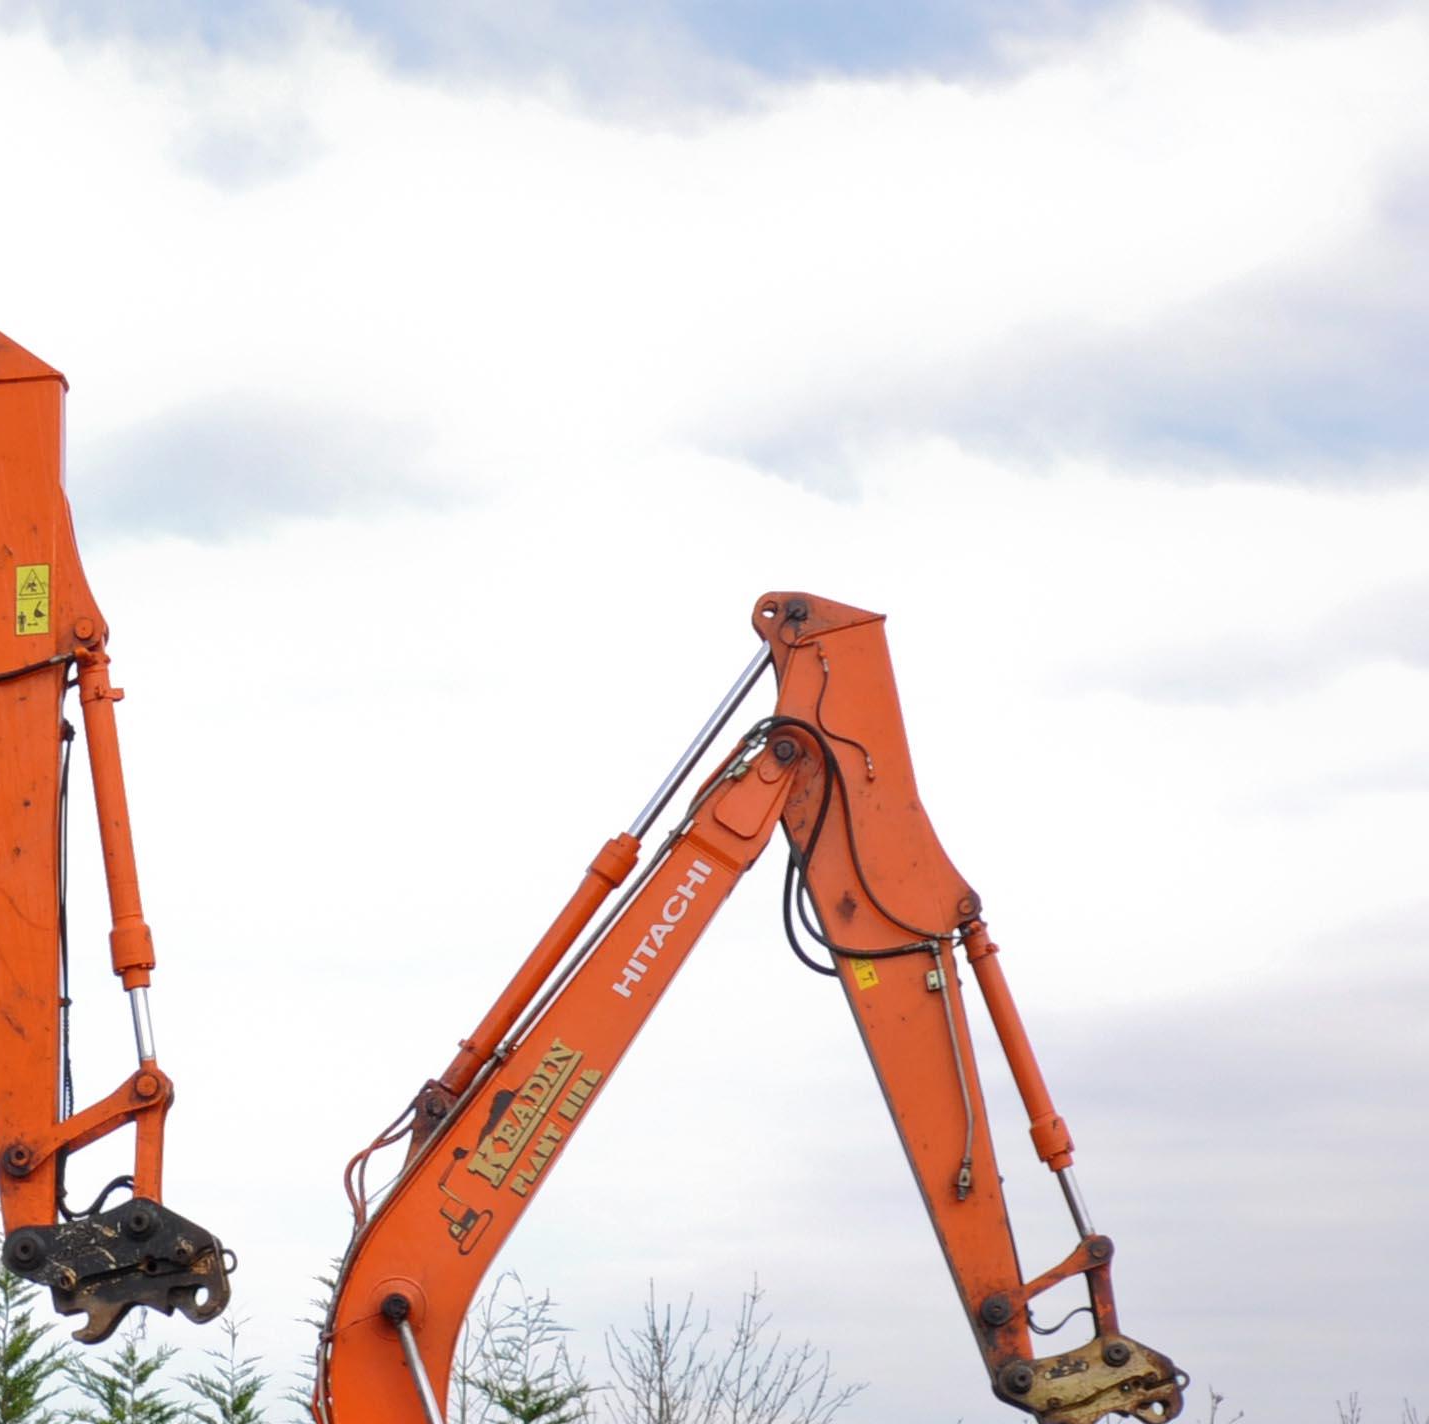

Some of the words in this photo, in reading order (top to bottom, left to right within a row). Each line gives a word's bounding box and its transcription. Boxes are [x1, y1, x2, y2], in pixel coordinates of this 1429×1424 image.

[612, 859, 713, 998] HITACHI
[467, 1037, 583, 1189] KEADIN
[509, 1122, 563, 1198] PLANT
